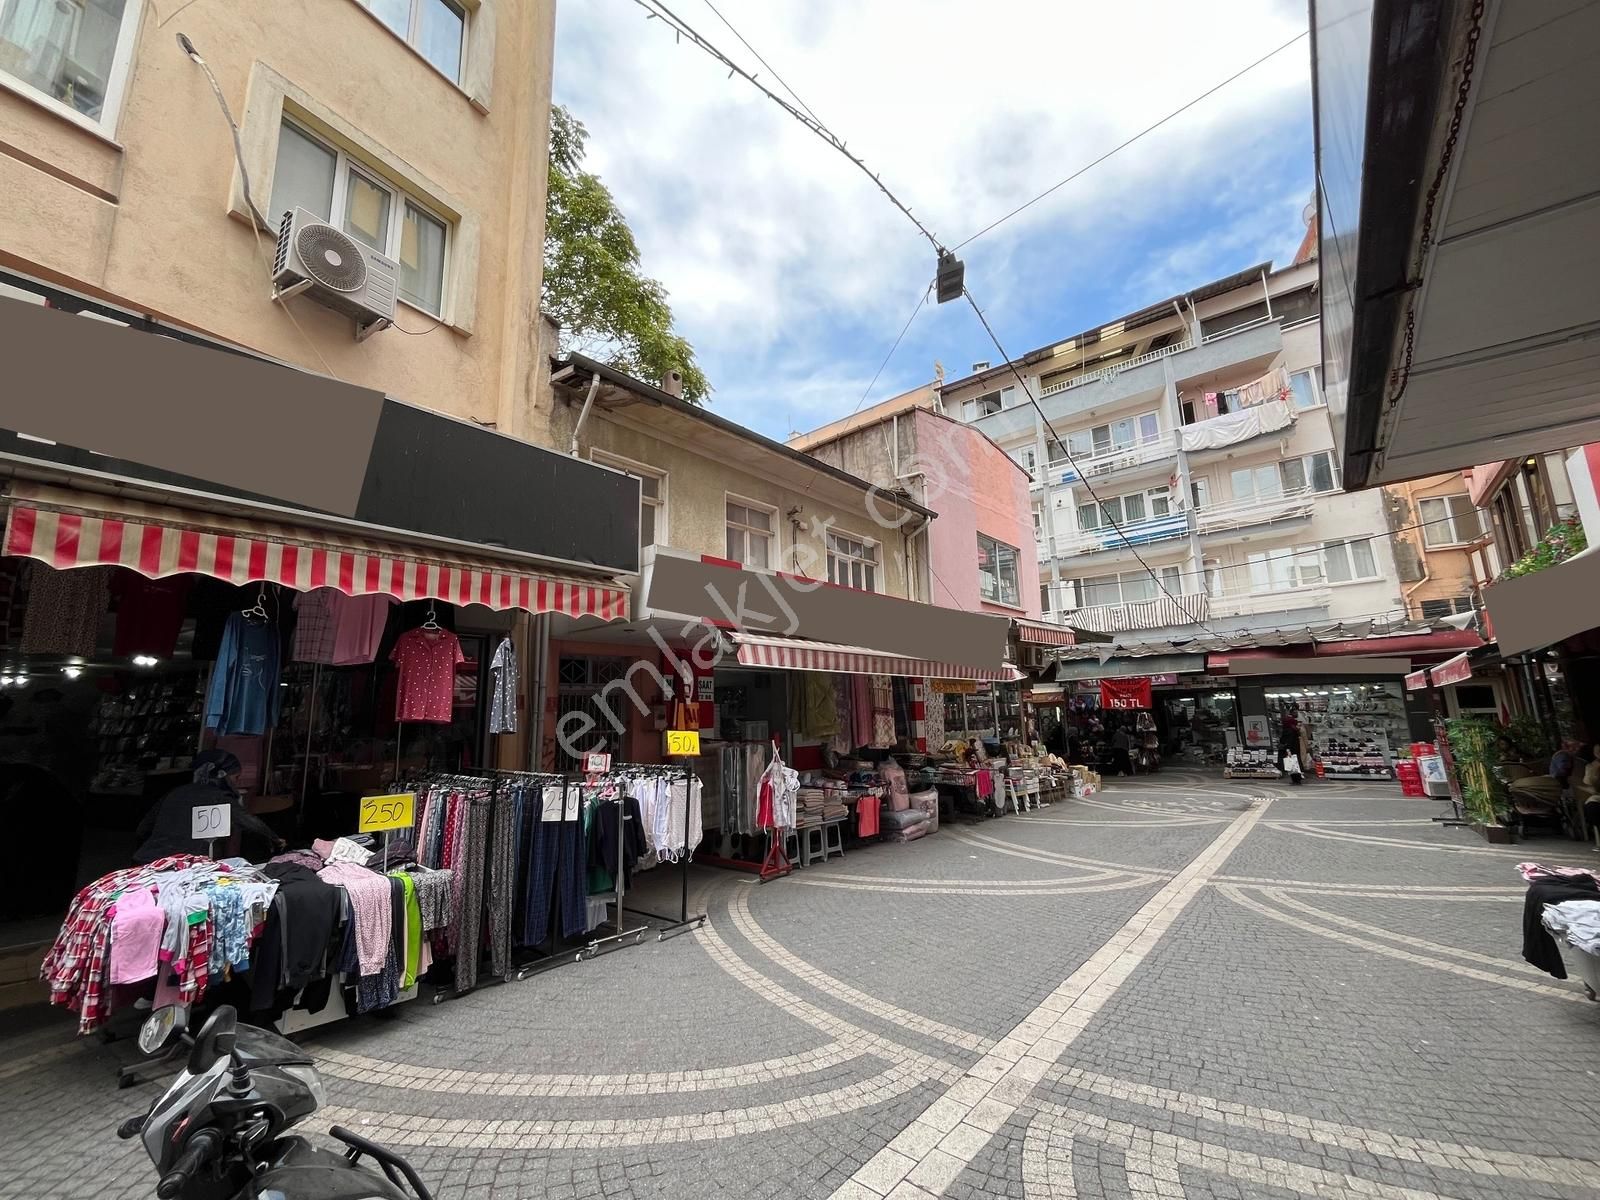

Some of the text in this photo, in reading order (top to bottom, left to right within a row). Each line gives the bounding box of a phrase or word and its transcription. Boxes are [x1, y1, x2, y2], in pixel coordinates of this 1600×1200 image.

[1110, 699, 1144, 708] 150 TL
[196, 807, 221, 832] 50
[364, 802, 404, 824] 250
